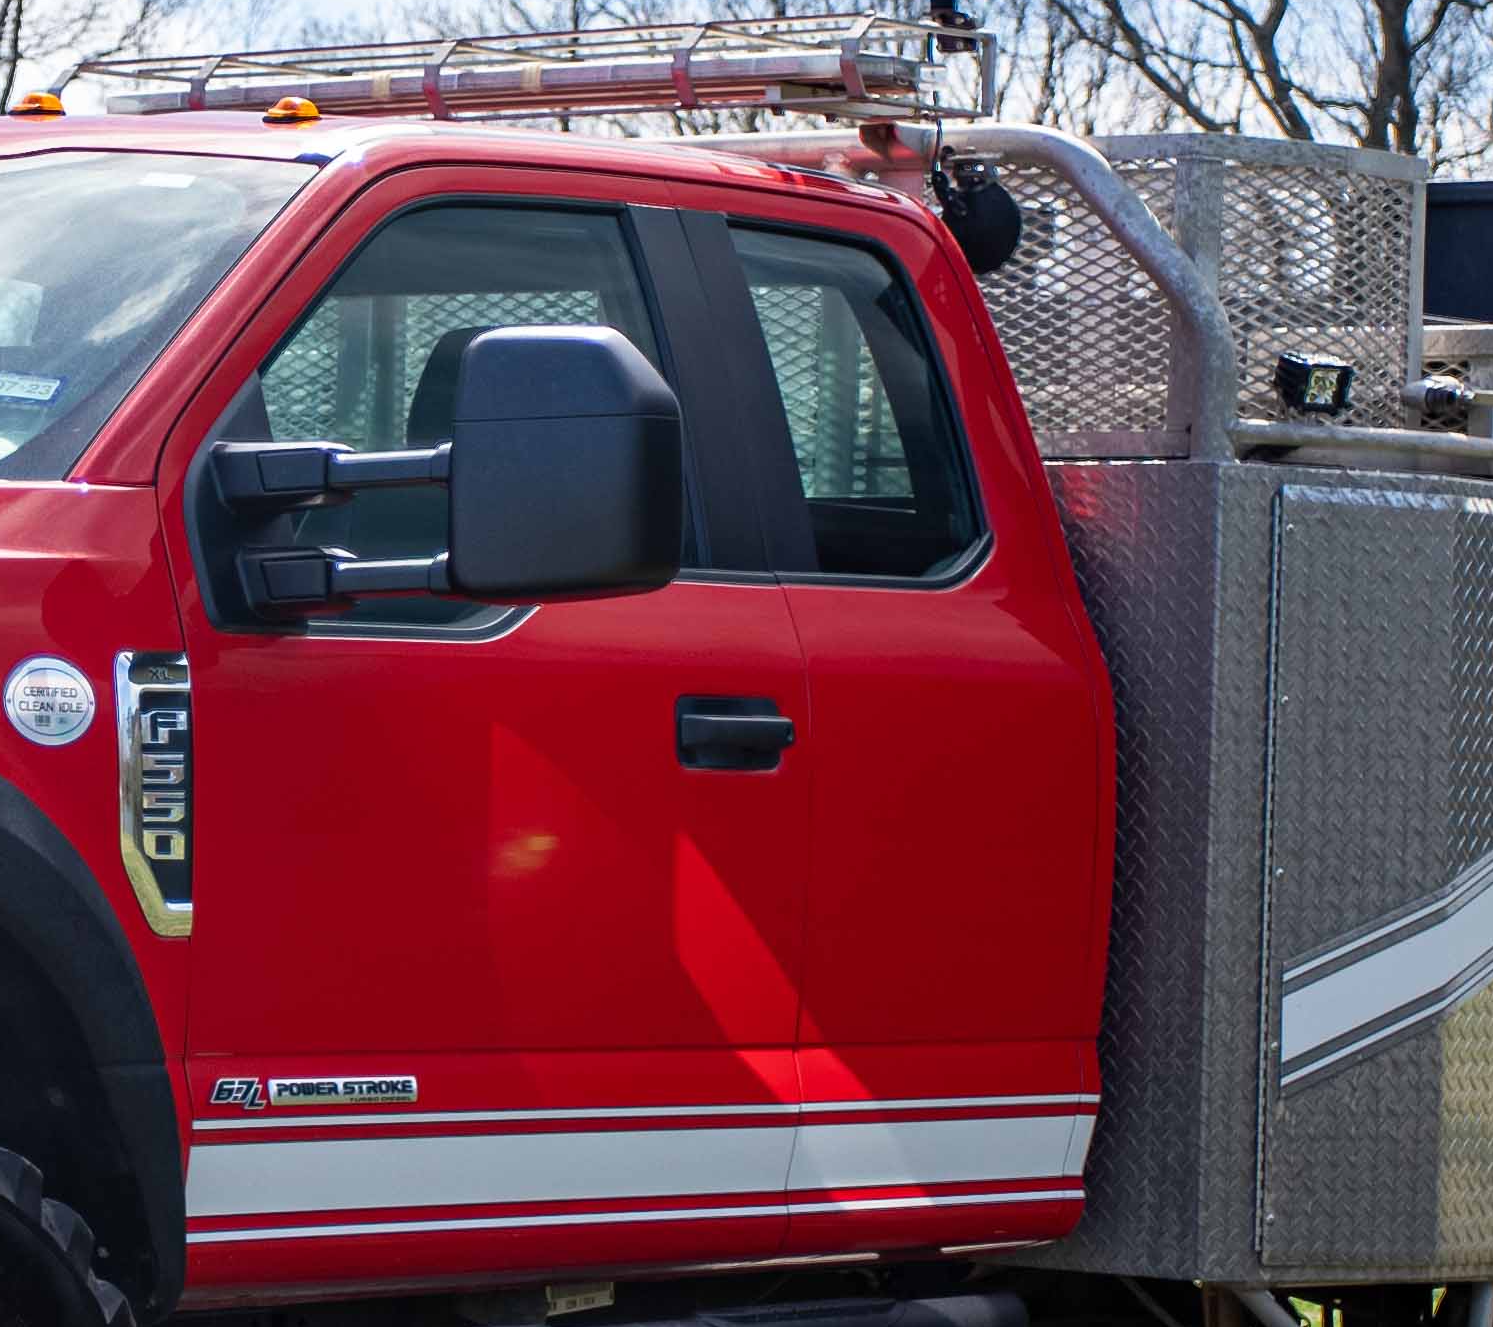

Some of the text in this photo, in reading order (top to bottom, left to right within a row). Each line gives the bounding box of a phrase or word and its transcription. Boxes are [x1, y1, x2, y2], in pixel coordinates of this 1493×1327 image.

[23, 686, 78, 698] CERTIFIED
[18, 700, 84, 713] CLEAN IDLE
[140, 710, 188, 861] F550
[211, 1078, 266, 1109] 6.7L
[276, 1079, 413, 1097] POWER STROKE
